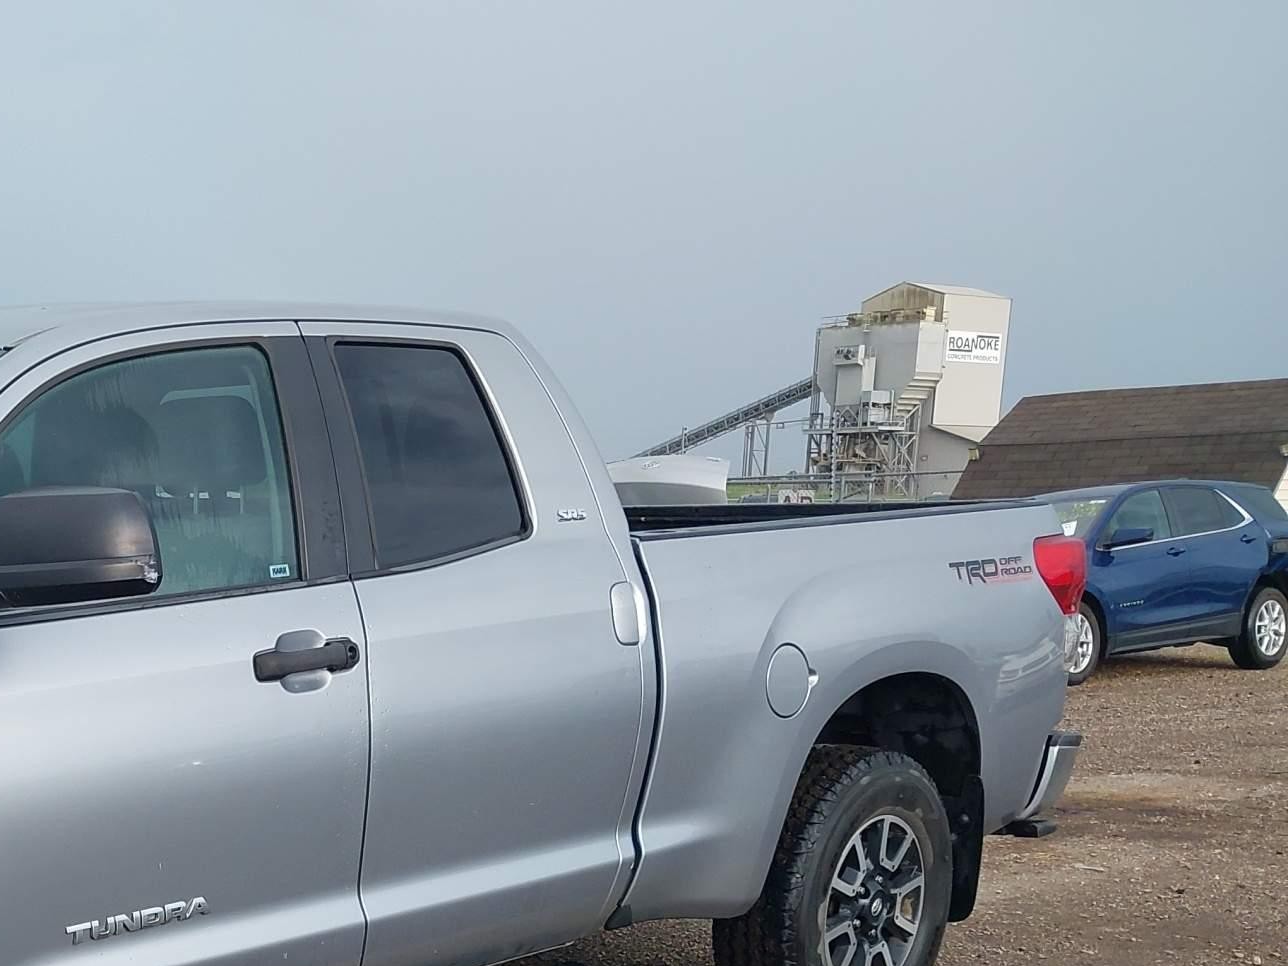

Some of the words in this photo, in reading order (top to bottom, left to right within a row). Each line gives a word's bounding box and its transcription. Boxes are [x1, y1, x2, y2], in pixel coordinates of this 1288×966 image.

[949, 335, 1000, 352] ROANOKE
[947, 353, 972, 361] CONCRETE
[973, 354, 999, 362] PRODUCTS
[557, 508, 587, 522] SR5
[948, 558, 999, 585] TRD
[999, 556, 1023, 566] OFF
[1000, 565, 1033, 577] ROAD
[65, 895, 212, 946] TUNDRA
